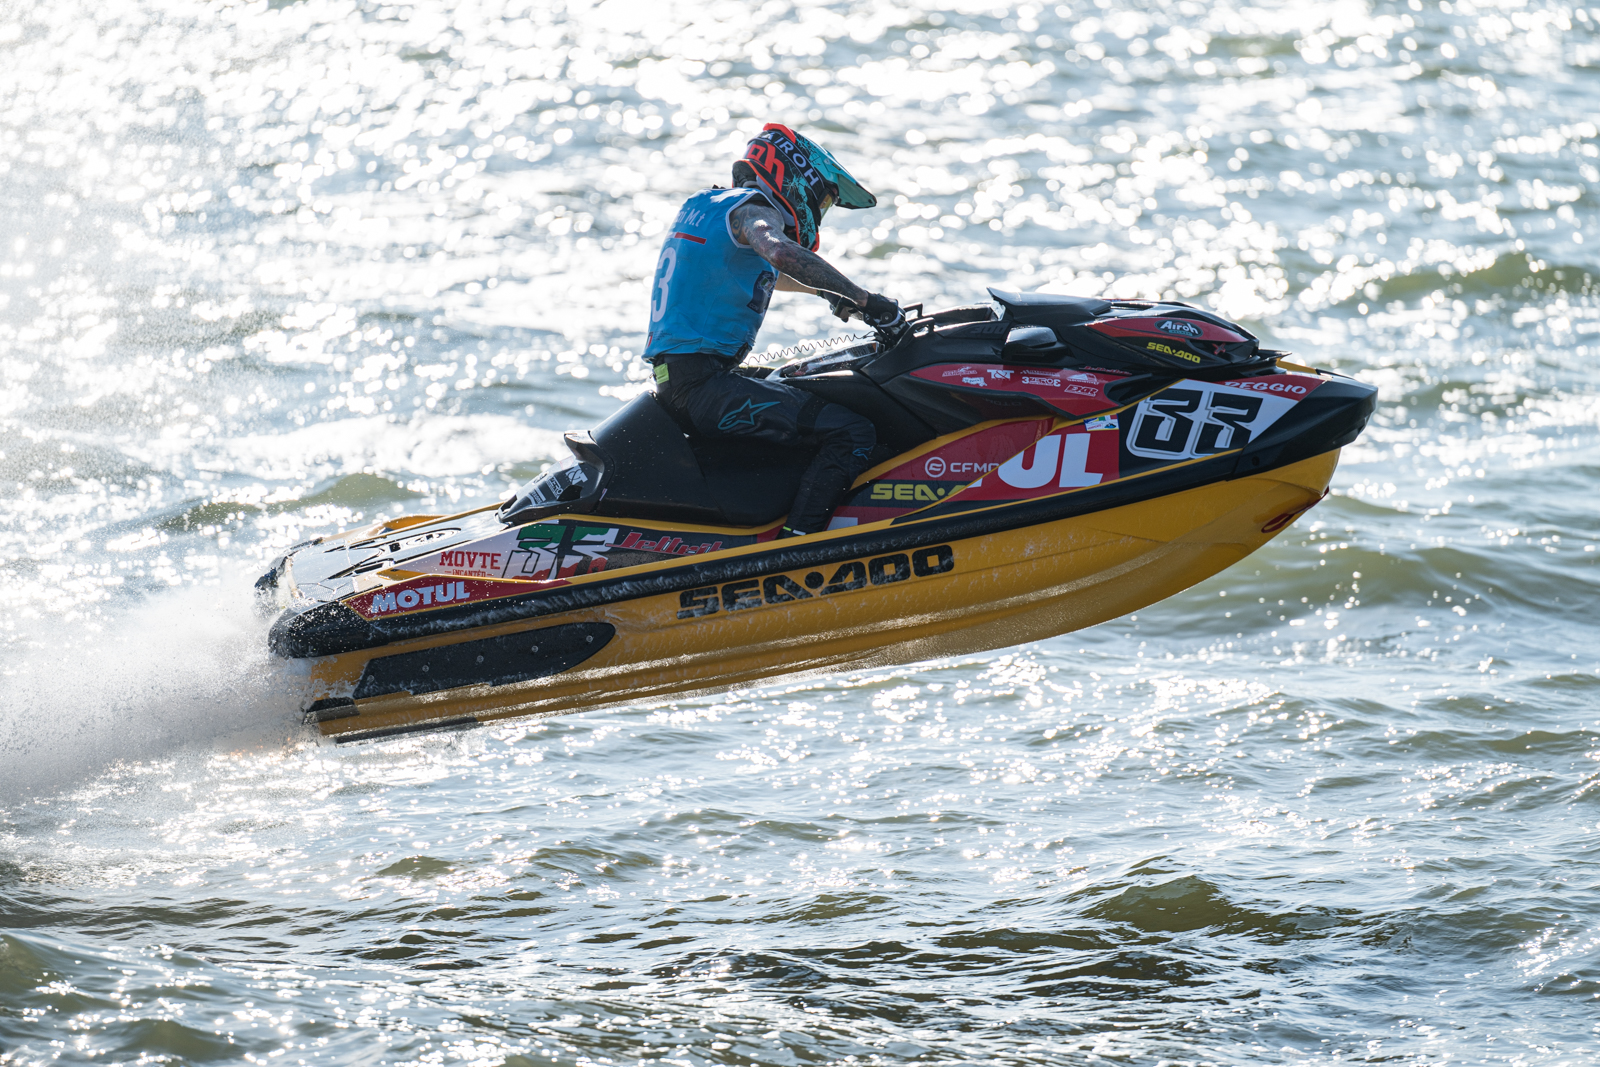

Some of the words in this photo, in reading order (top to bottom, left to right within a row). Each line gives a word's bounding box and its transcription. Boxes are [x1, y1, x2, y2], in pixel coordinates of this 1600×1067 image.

[967, 432, 1104, 489] UL
[439, 550, 502, 570] MOVTE
[371, 581, 471, 614] MOTUL
